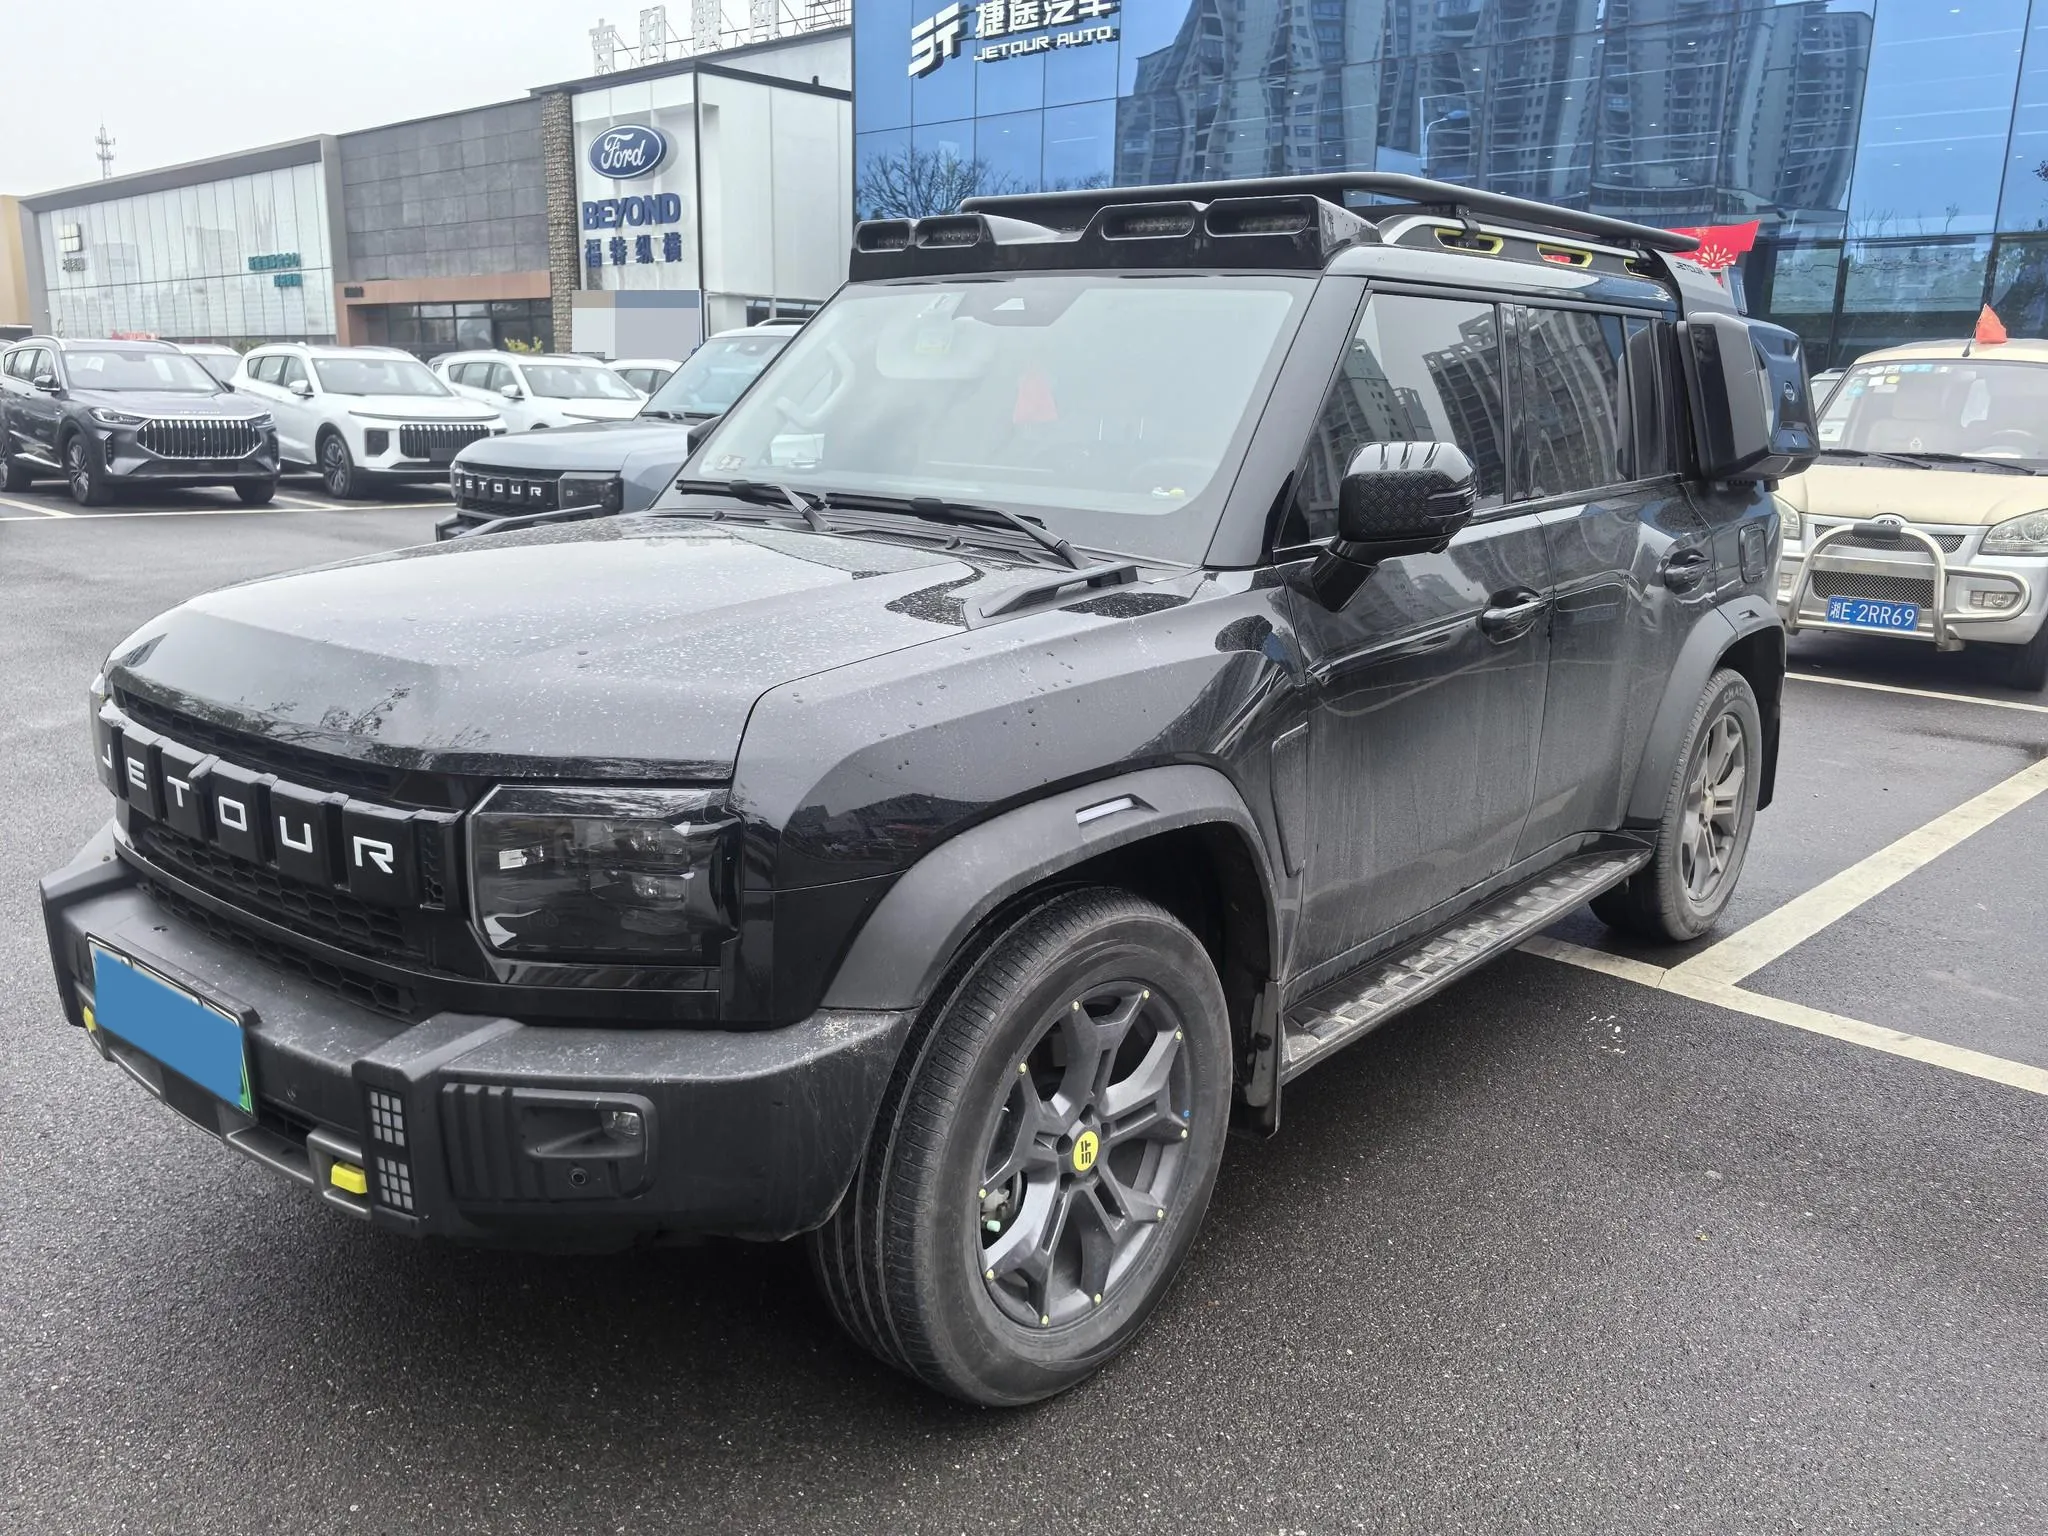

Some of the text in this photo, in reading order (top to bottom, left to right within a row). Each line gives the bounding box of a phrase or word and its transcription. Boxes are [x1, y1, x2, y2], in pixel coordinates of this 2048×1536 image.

[974, 25, 1112, 61] JETOUR AUTO
[601, 133, 646, 169] Ford
[582, 193, 681, 230] BEYOND
[585, 232, 682, 268] 福特纵横
[455, 480, 542, 497] JETOUR
[101, 743, 395, 875] JETOUR
